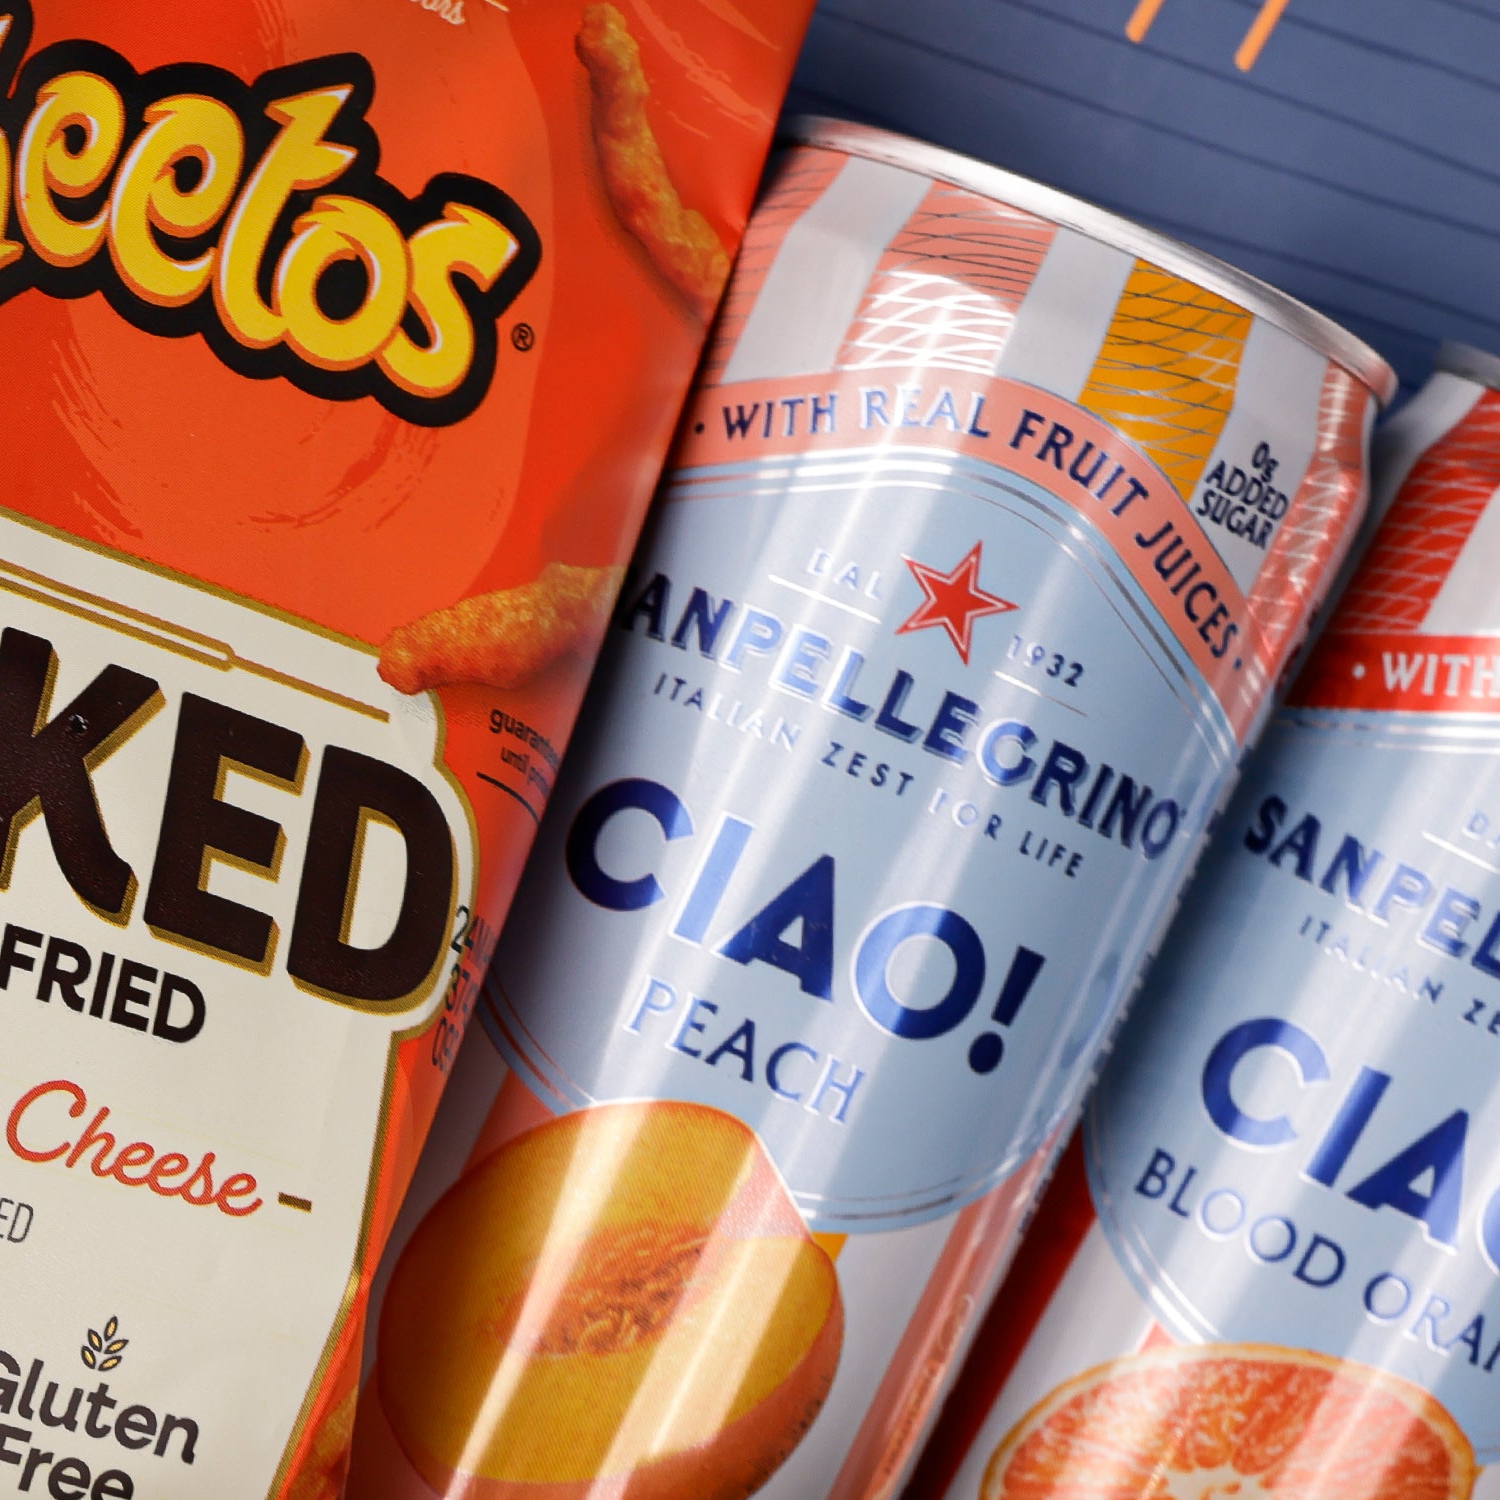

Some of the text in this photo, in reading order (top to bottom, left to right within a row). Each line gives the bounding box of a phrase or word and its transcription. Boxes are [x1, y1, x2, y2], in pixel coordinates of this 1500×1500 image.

[723, 387, 1238, 658] WITH REAL FRUIT JUICES
[1197, 489, 1273, 550] SUGAR
[1205, 460, 1289, 520] ADDED
[808, 547, 884, 601] DAL
[1007, 635, 1084, 687] 1932
[1381, 651, 1500, 698] WITH
[654, 673, 1086, 880] ITALIAN ZEST FOR LIFE
[565, 777, 1045, 1075] CIAO!
[623, 975, 867, 1125] PEACH
[4, 1080, 263, 1218] Cheese
[1202, 1016, 1500, 1275] CIA
[1135, 1147, 1347, 1288] BLOOD
